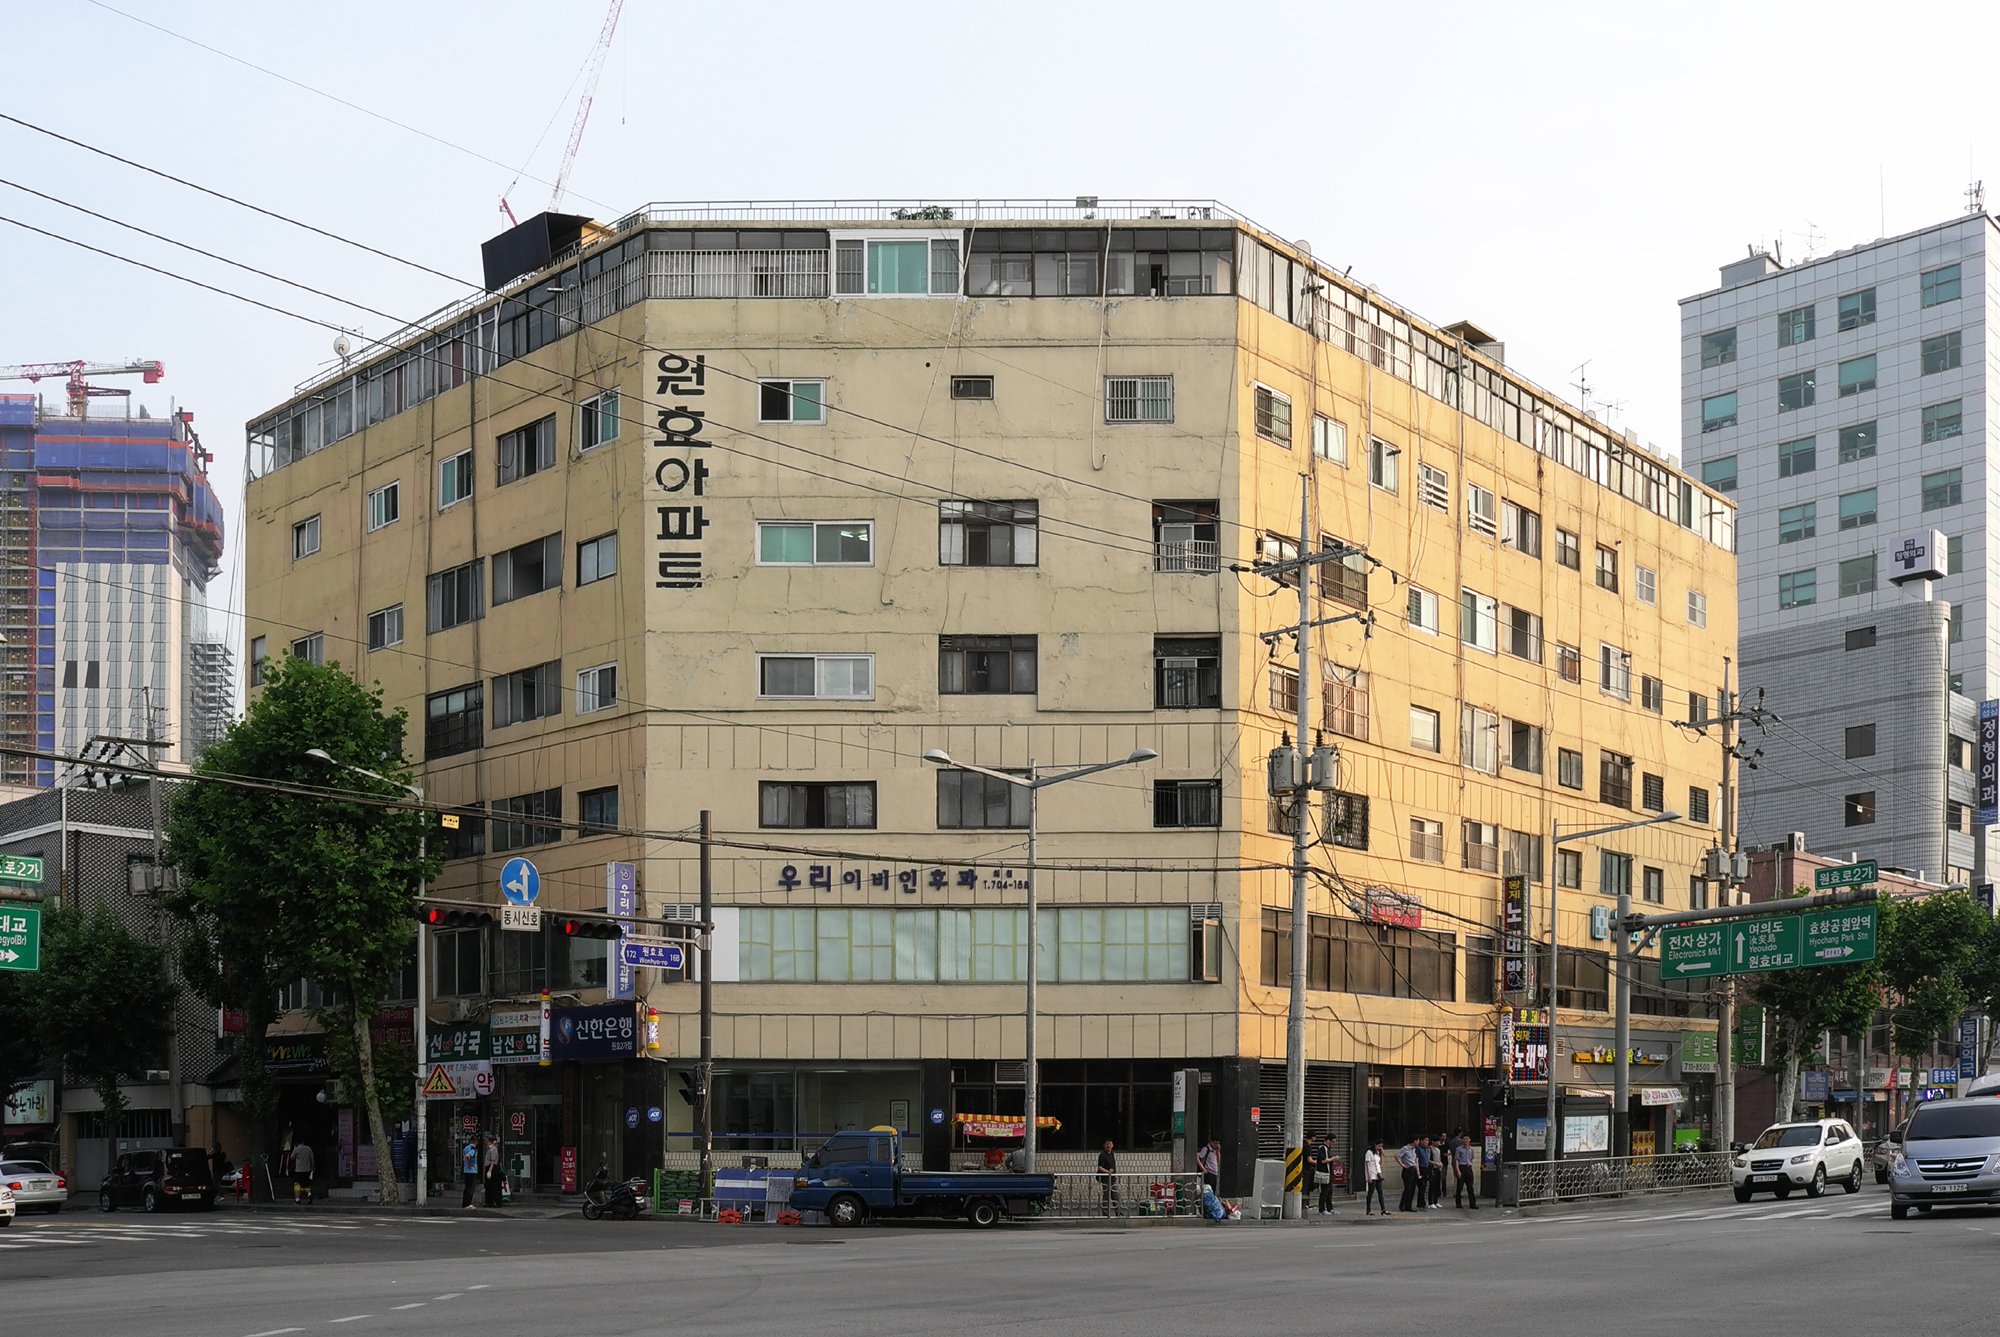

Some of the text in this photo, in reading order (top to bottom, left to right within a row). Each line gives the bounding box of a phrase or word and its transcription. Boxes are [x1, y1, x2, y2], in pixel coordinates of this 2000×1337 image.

[653, 355, 711, 589] 원효아파트
[1981, 719, 1997, 804] 정형외과
[0, 861, 39, 878] 로2가
[1819, 866, 1873, 886] 원효로2가
[778, 865, 978, 893] 우리이비인후과
[503, 910, 538, 927] 동시신호
[1809, 915, 1872, 935] 효창공원앞역
[1749, 921, 1784, 935] 여의도
[1668, 931, 1722, 950] 전자상가
[1749, 943, 1778, 953] Yeouido
[1809, 931, 1869, 948] Hyochang Park Stn
[626, 950, 637, 959] 172
[642, 946, 665, 957] 원효로
[670, 953, 680, 963] 168
[1668, 947, 1722, 961] Electronics Mkt
[639, 957, 668, 967] Wonhyo-ro
[1748, 953, 1794, 969] 원효대교
[575, 1017, 633, 1040] 신한은행
[425, 1030, 480, 1059] 선약국
[493, 1033, 541, 1056] 남선약
[1742, 1026, 1758, 1064] 부동산
[1962, 1020, 1976, 1077] 동명약국
[1684, 1062, 1710, 1072] 711-8500
[477, 1072, 493, 1093] 약
[463, 1115, 477, 1133] 약
[511, 1112, 525, 1135] 약
